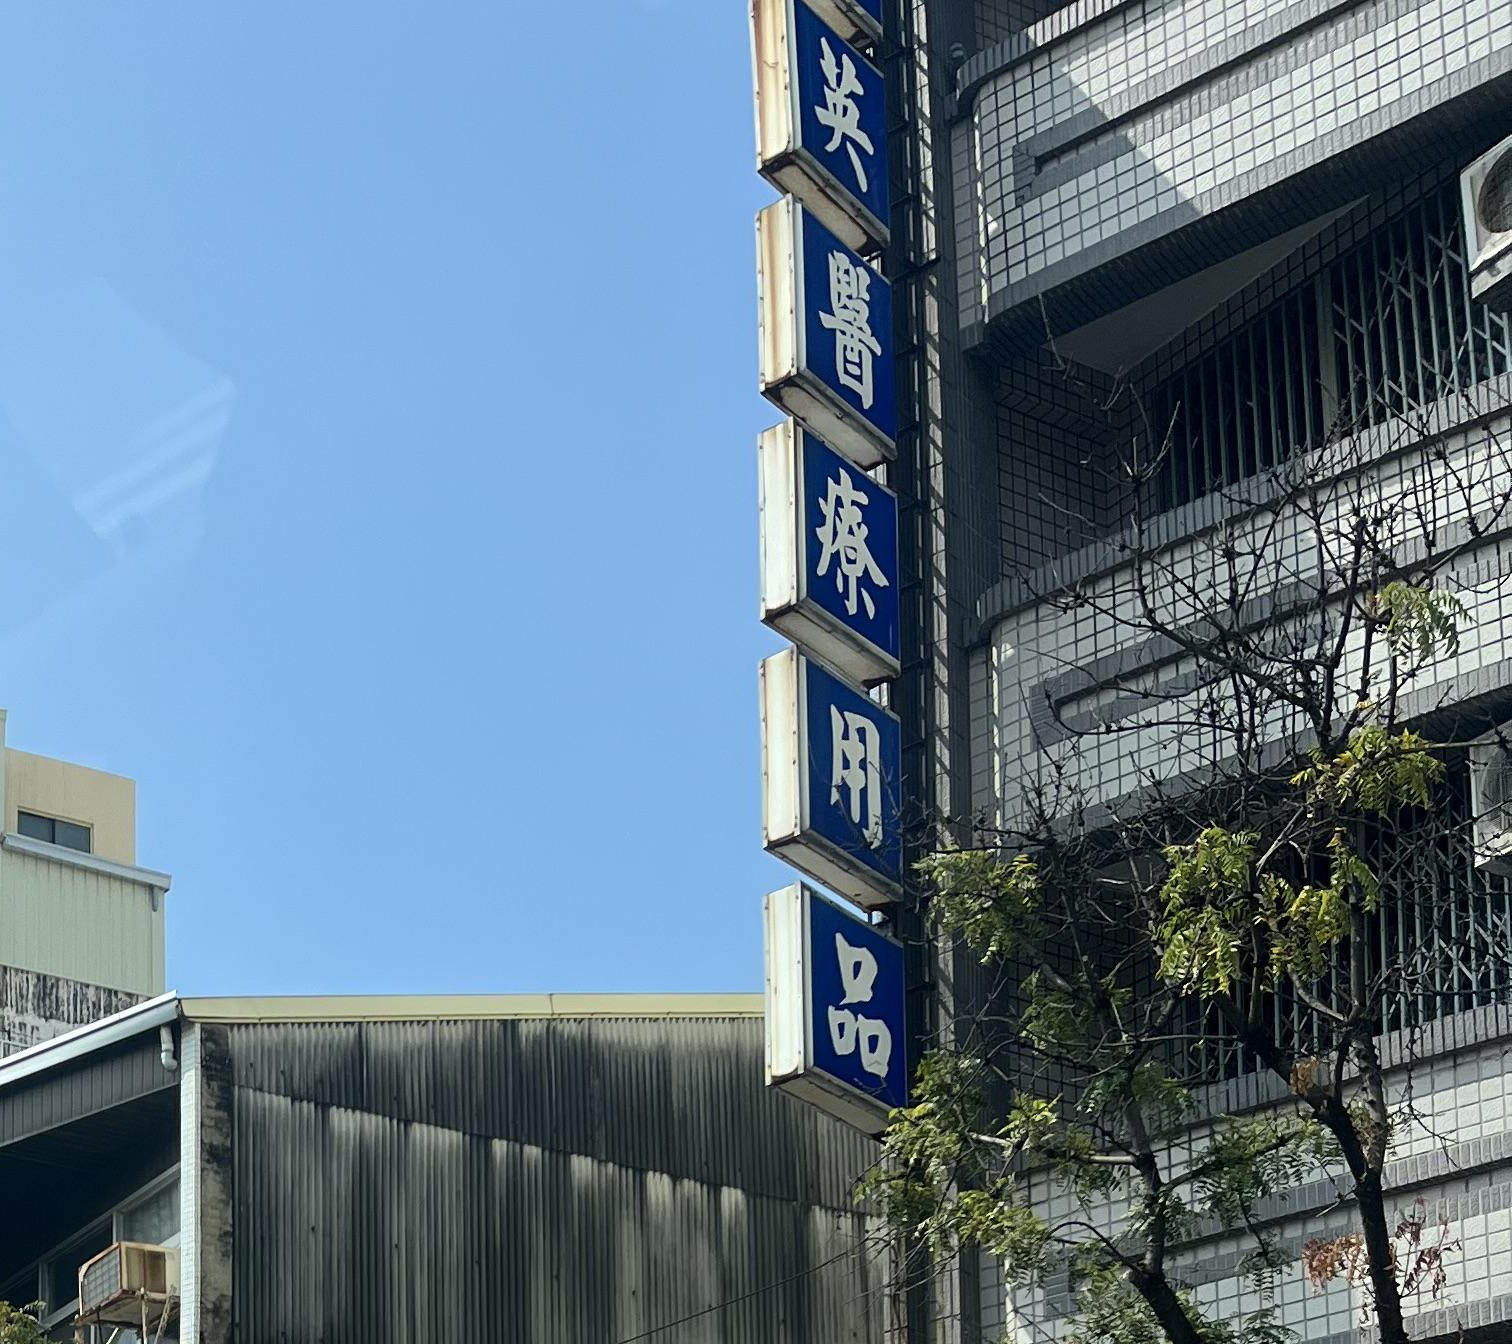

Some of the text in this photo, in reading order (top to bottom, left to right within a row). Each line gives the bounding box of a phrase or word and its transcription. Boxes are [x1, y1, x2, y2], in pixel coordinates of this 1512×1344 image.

[814, 36, 892, 1078] 英醫療用品
